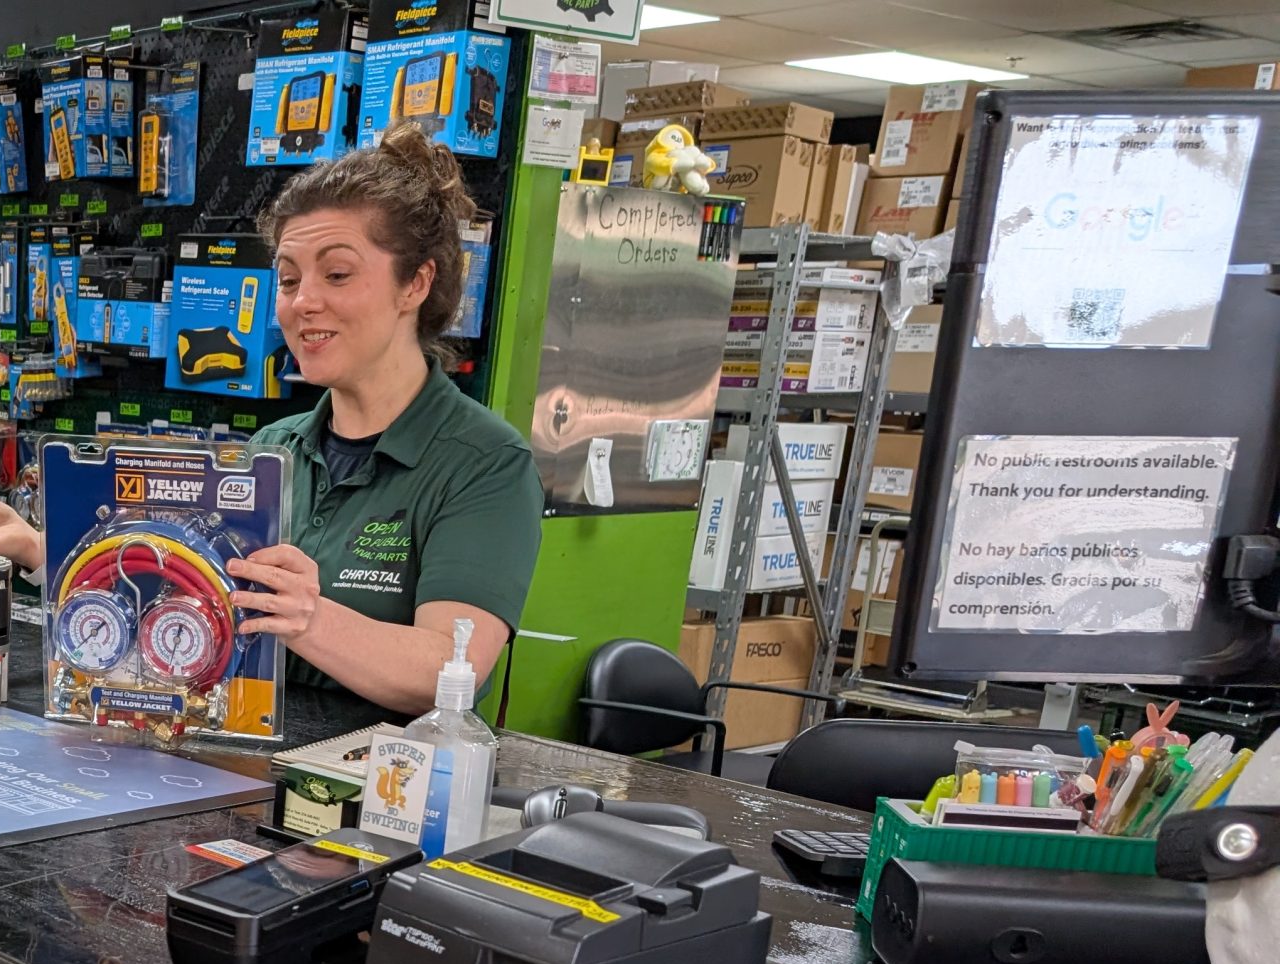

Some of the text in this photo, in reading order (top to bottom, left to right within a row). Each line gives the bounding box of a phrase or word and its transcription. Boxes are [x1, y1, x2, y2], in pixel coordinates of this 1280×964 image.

[396, 6, 437, 21] Fieldpiece
[282, 26, 318, 39] Fieldpiece
[387, 41, 424, 52] Refrigerant
[425, 36, 455, 46] Manifold
[280, 57, 307, 68] Refrigerant
[308, 56, 334, 65] Manifold
[1017, 123, 1043, 132] Want
[599, 194, 697, 236] Completed
[208, 245, 236, 256] Fieldpiece
[617, 238, 678, 264] Orders
[181, 276, 205, 285] Wireless
[181, 285, 229, 296] Refrigerant Scale
[784, 443, 834, 460] TRUELINE
[115, 457, 204, 470] Charging Manifold and Hoses
[974, 453, 1219, 470] No public restrooms available.
[147, 478, 204, 492] YELLOW
[226, 482, 245, 493] A2L
[969, 483, 1209, 502] Thank you for understanding.
[147, 490, 202, 502] JACKET
[772, 500, 824, 518] TRELINE
[363, 521, 403, 534] OPEN
[704, 498, 723, 558] TRUELINE
[354, 536, 412, 547] TO PUBLIC
[353, 546, 408, 561] HVAC PARTS
[959, 542, 1138, 560] No hay baños públicos
[762, 553, 799, 570] TRUEL
[339, 569, 401, 584] CHRYSTAL
[953, 572, 1162, 590] disponibles. Gracias por su
[352, 581, 383, 591] knowledge
[383, 585, 403, 593] junkie
[949, 602, 1055, 616] comprensión.
[746, 642, 782, 657] FASCO
[101, 689, 112, 697] Test
[124, 691, 148, 700] Charging
[148, 694, 173, 702] Manifold
[111, 699, 172, 711] YELLOW JACKET
[378, 742, 426, 766] SWIPER
[26, 772, 58, 784] Our
[14, 779, 82, 804] Business
[363, 811, 419, 834] SWIPING!
